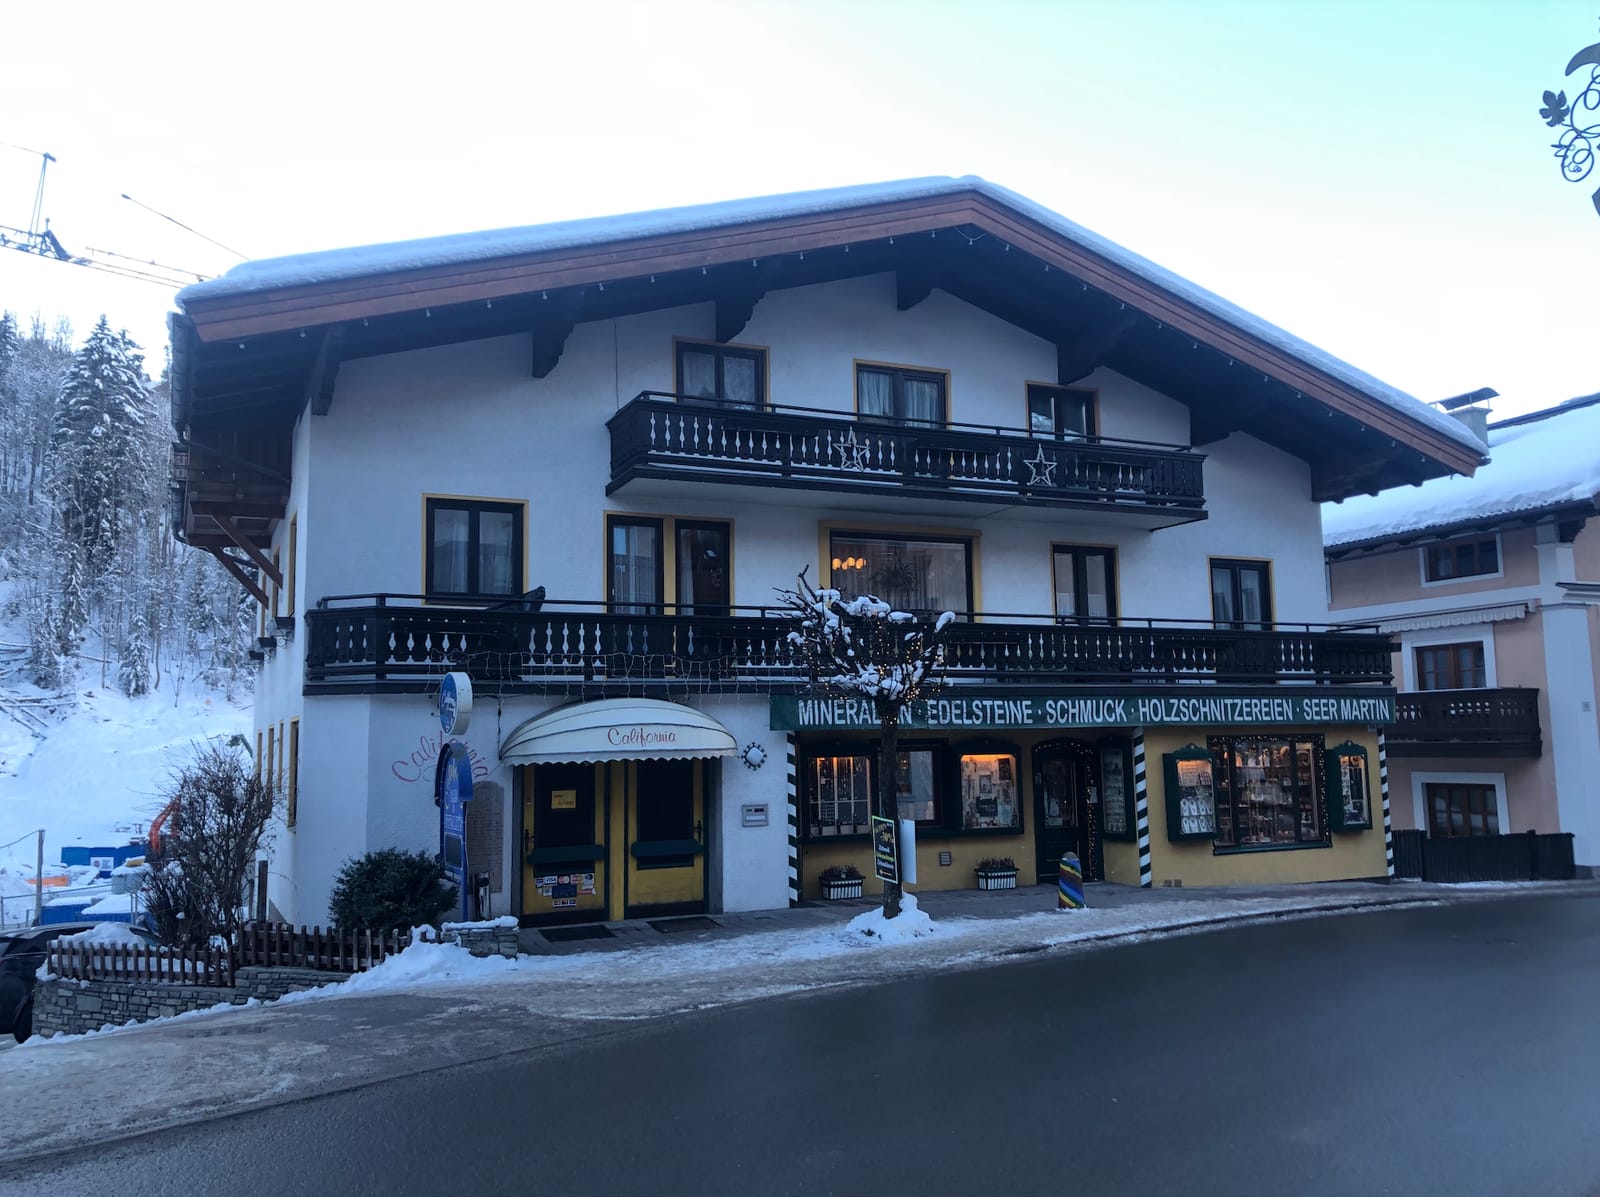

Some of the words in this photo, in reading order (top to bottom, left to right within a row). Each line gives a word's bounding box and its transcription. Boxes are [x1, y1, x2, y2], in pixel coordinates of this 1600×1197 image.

[927, 699, 1033, 725] EDELSTEINE
[1046, 699, 1127, 724] SCHMUCK
[1138, 698, 1293, 722] HOLZSCHNITZEREIEN
[1303, 698, 1338, 721] SEER
[1340, 698, 1390, 721] MARTIN
[607, 727, 676, 747] California
